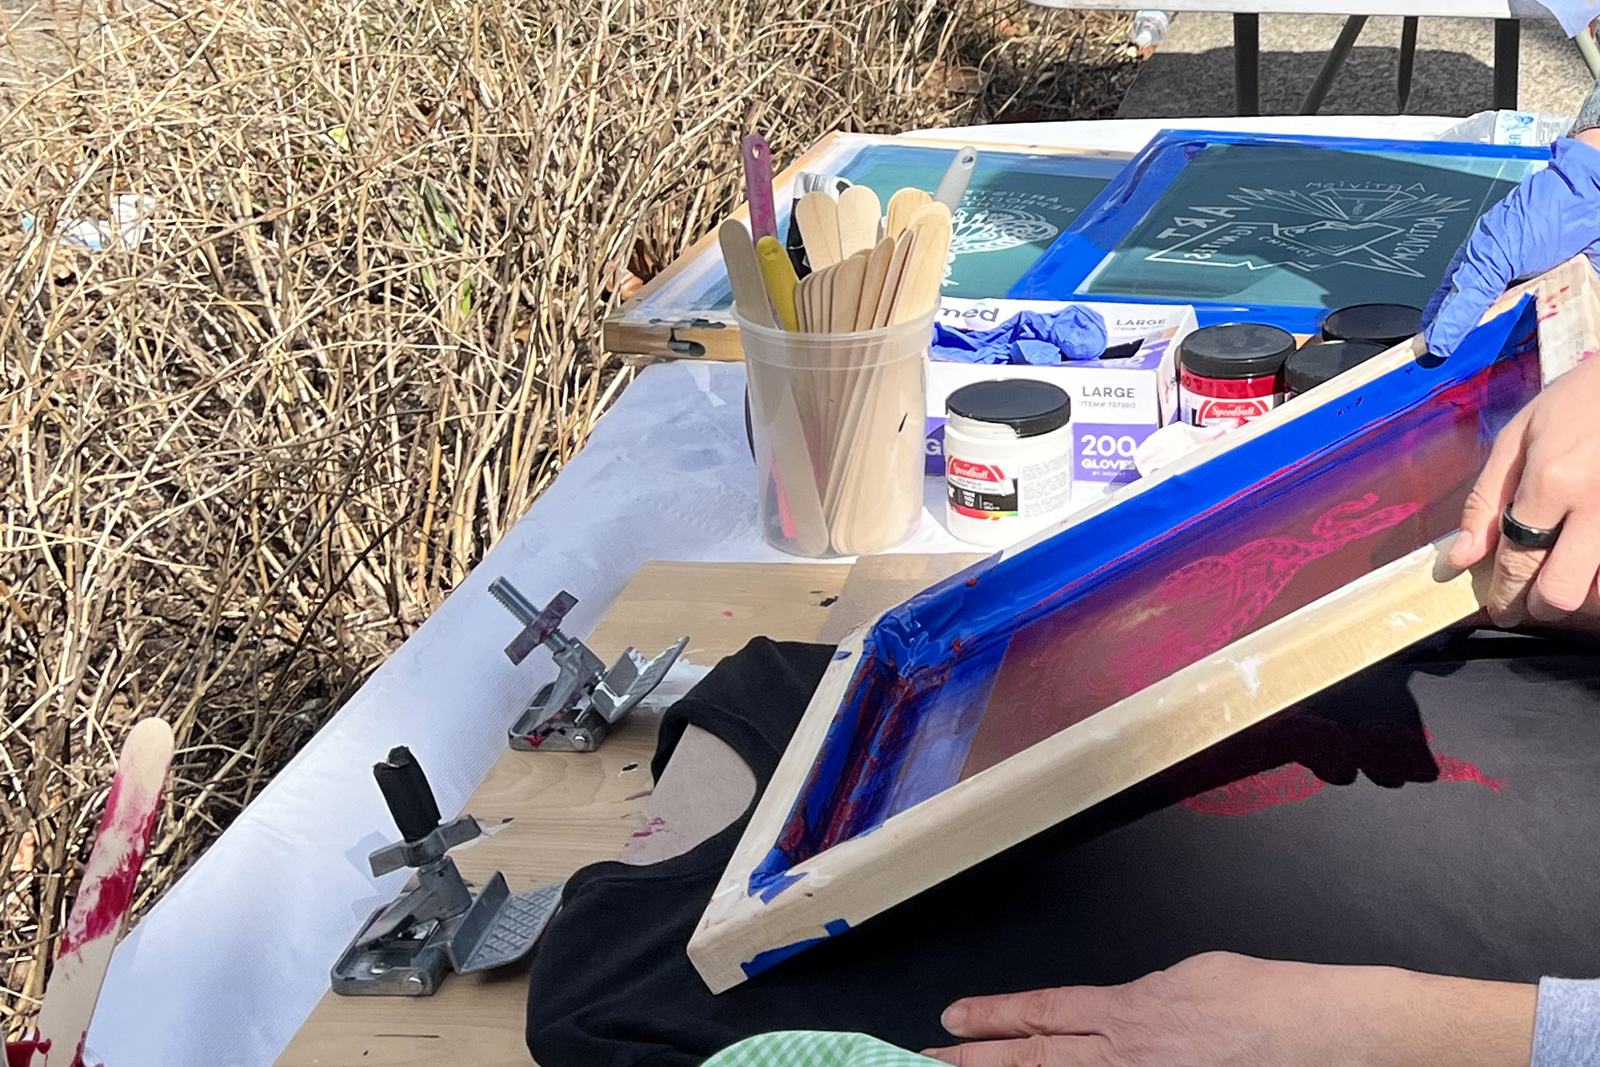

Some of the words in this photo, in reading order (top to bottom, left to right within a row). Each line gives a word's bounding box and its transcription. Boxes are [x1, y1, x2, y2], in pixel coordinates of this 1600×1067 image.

[1116, 318, 1167, 326] LARGE
[1082, 386, 1136, 399] LARGE
[1211, 404, 1255, 418] Speedball
[1081, 434, 1136, 458] 200
[952, 462, 989, 480] Speedball
